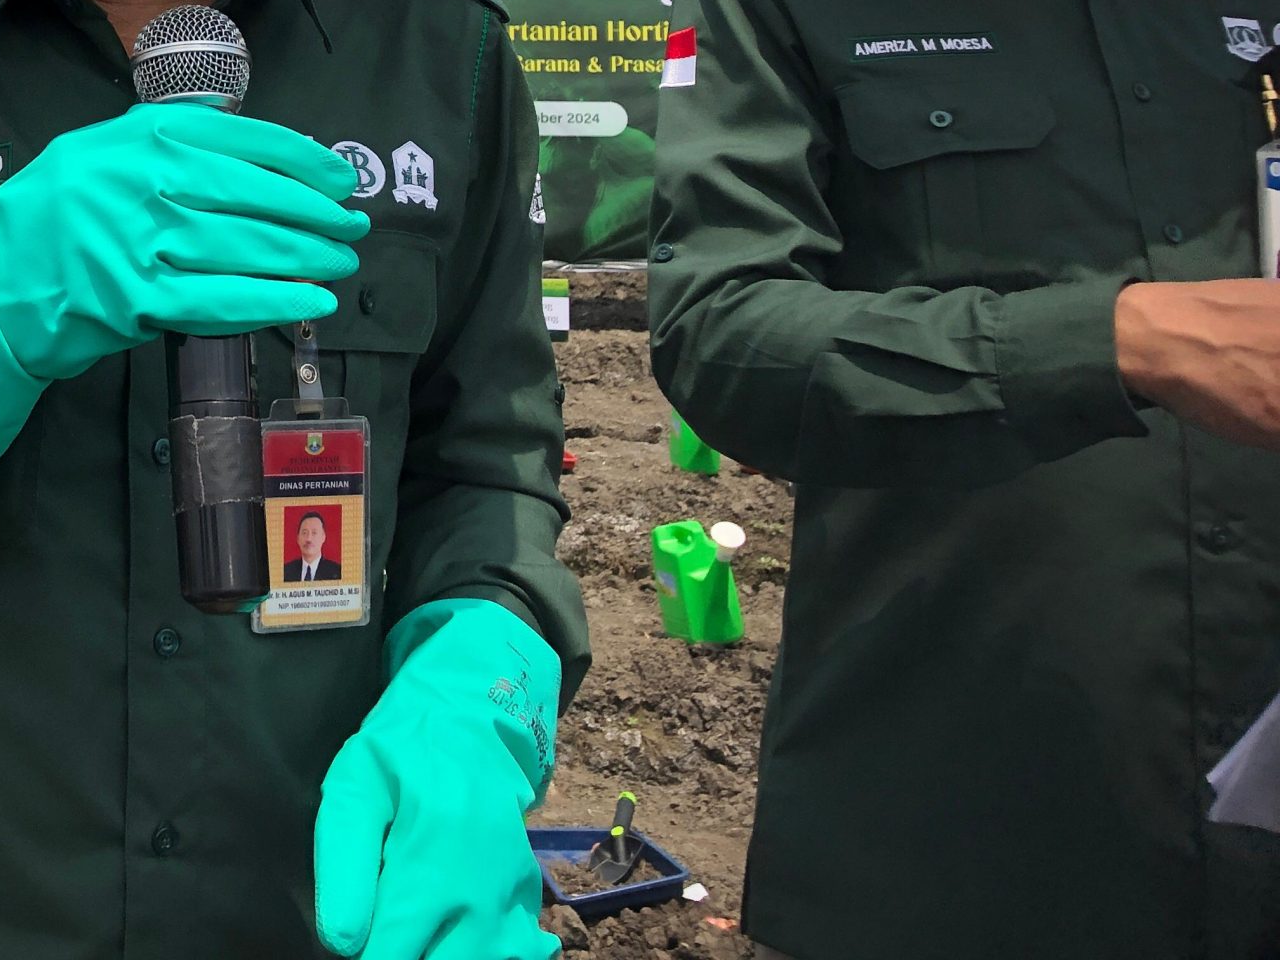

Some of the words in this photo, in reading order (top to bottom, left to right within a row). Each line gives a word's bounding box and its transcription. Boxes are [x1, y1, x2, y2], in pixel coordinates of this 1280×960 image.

[607, 20, 669, 41] Horti
[855, 39, 918, 56] AMERIZA
[921, 38, 936, 51] M
[940, 37, 992, 50] MOESA
[587, 55, 602, 72] &
[567, 113, 600, 124] 2024
[280, 481, 303, 490] DINAS
[305, 481, 349, 489] PERTANIAN
[289, 590, 305, 598] AGUS
[314, 589, 339, 597] TAUCHID
